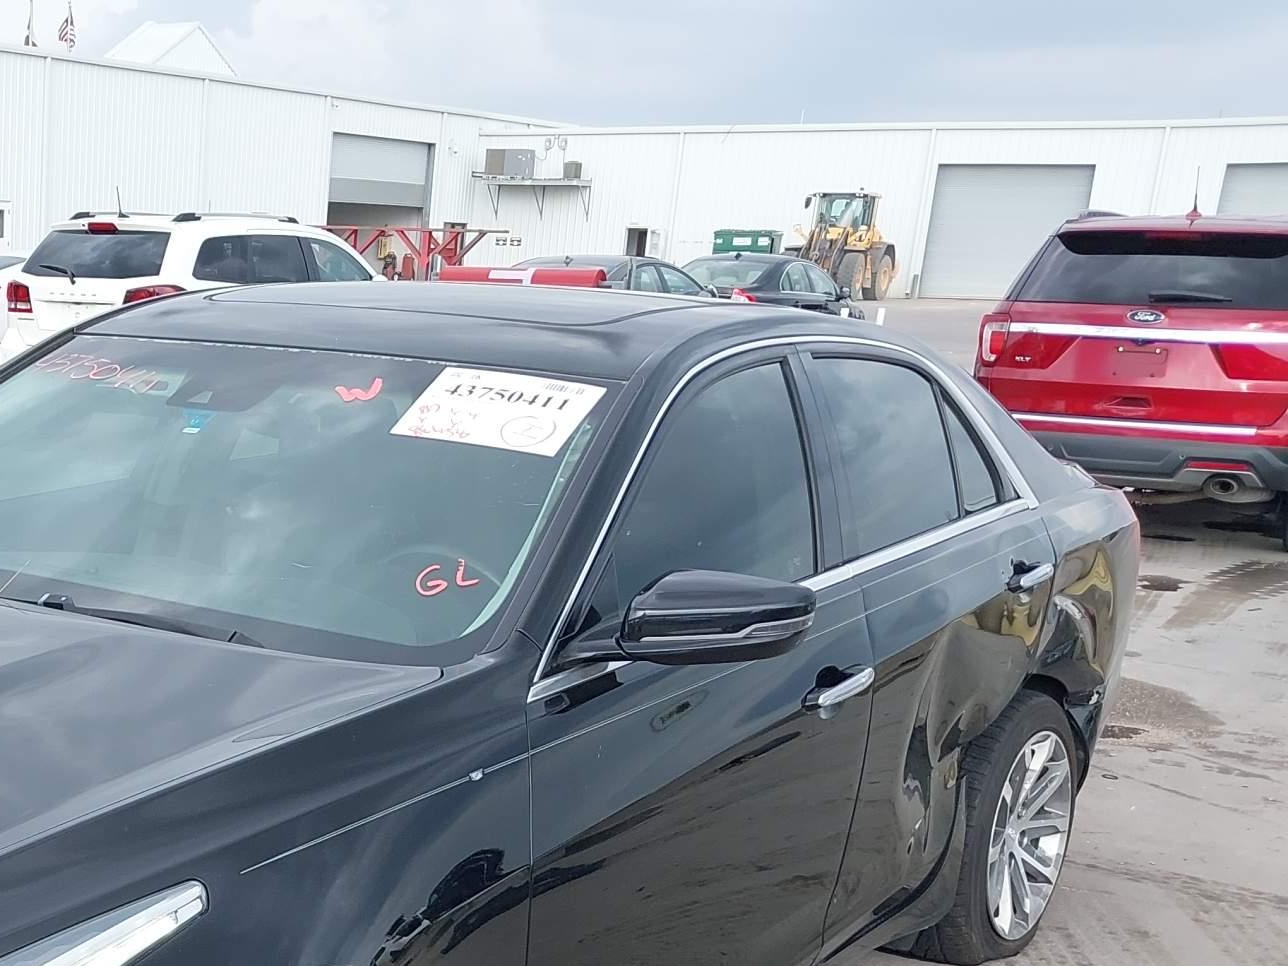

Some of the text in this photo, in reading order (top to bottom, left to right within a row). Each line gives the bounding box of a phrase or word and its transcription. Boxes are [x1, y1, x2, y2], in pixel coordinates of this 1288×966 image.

[35, 353, 157, 394] 43750411
[334, 377, 383, 402] W
[444, 382, 571, 411] 43750411
